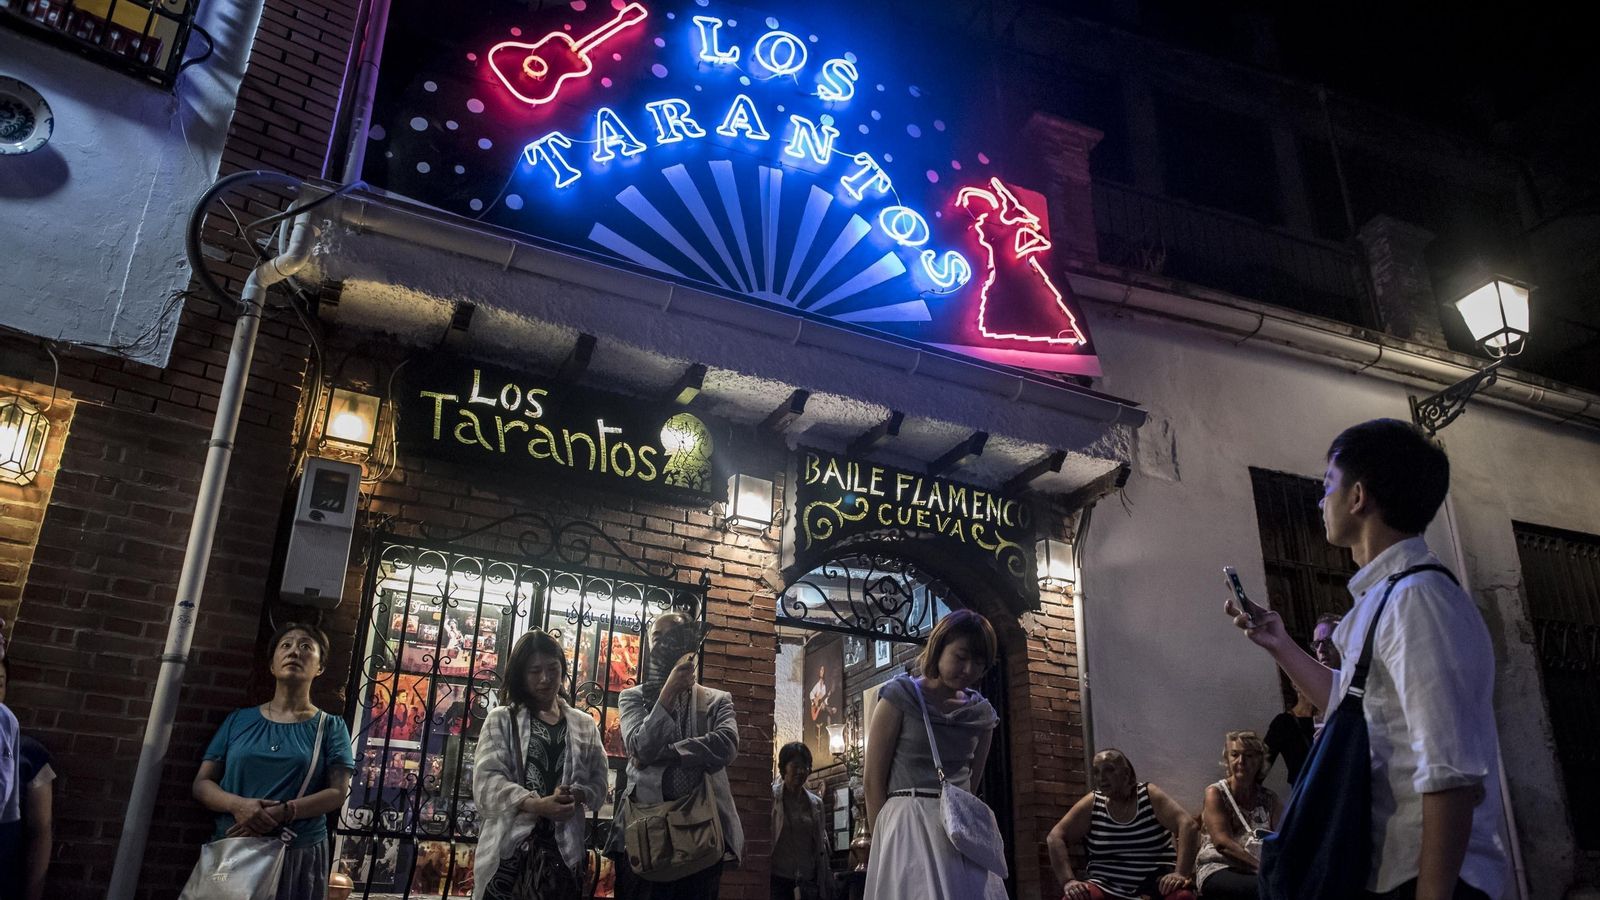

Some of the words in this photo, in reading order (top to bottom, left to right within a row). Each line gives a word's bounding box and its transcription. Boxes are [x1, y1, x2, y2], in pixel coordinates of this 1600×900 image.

[693, 15, 858, 101] LOS
[524, 94, 972, 288] TARANTOS
[420, 390, 658, 482] Tarantos
[806, 455, 885, 497] BAILE
[896, 473, 1031, 529] FLAMENCO
[878, 503, 966, 542] CUEVA
[566, 608, 596, 622] LOAL
